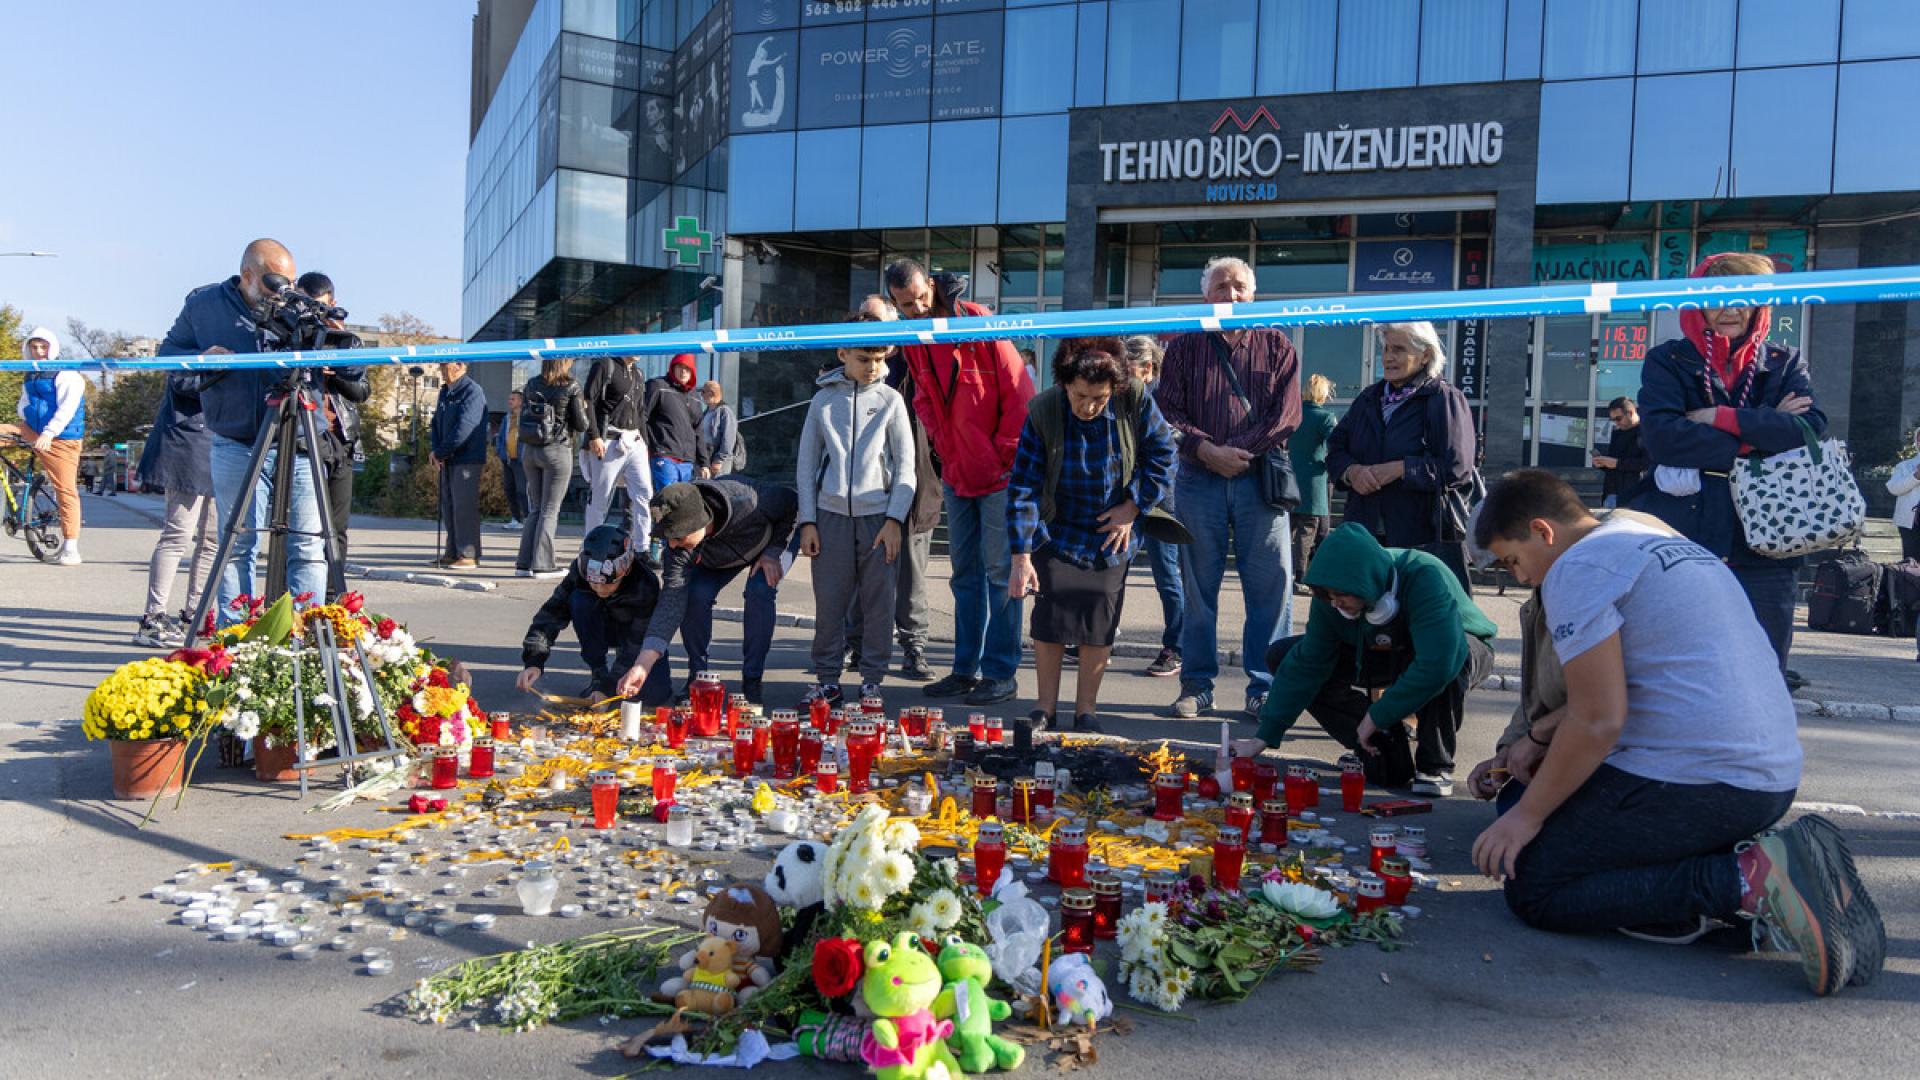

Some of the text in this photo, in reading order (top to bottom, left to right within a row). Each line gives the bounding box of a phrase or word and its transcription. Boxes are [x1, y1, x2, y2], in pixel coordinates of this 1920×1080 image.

[820, 48, 889, 66] POWER
[884, 88, 901, 98] the
[1100, 138, 1204, 182] TEHNO
